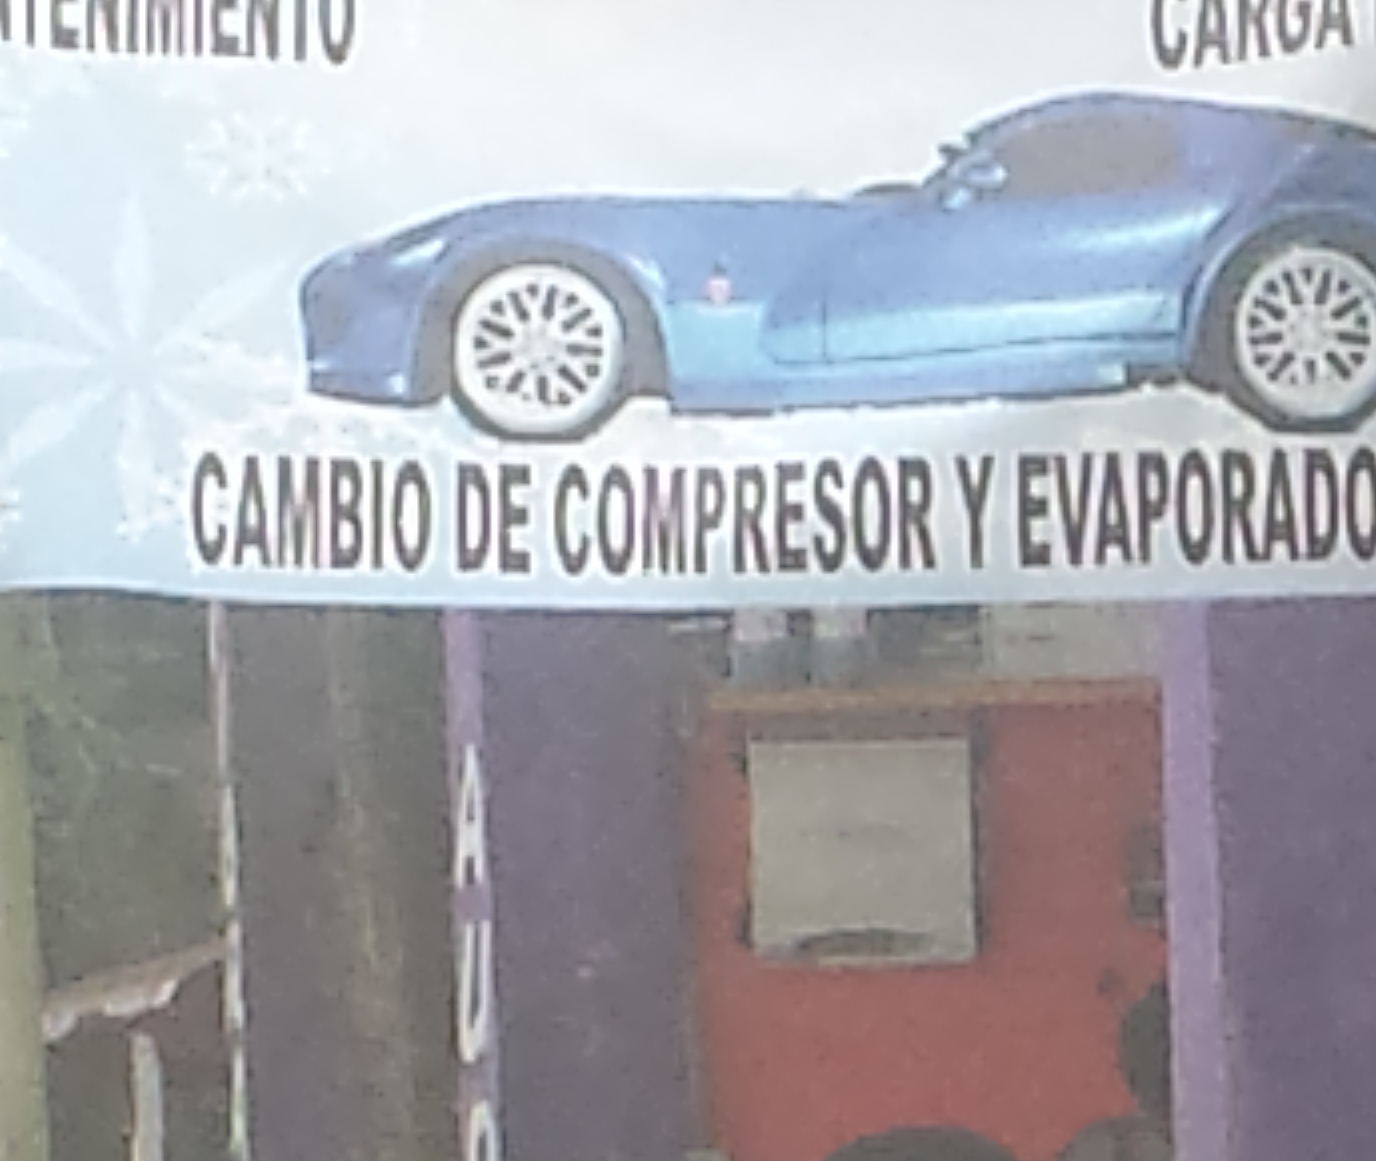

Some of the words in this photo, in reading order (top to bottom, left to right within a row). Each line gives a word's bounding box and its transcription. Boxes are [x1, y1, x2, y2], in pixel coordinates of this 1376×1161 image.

[1150, 0, 1353, 70] CARGA
[191, 451, 431, 571] CAMBIO
[455, 463, 531, 574] DE
[553, 456, 936, 575] COMPRESOR
[953, 455, 995, 569] Y
